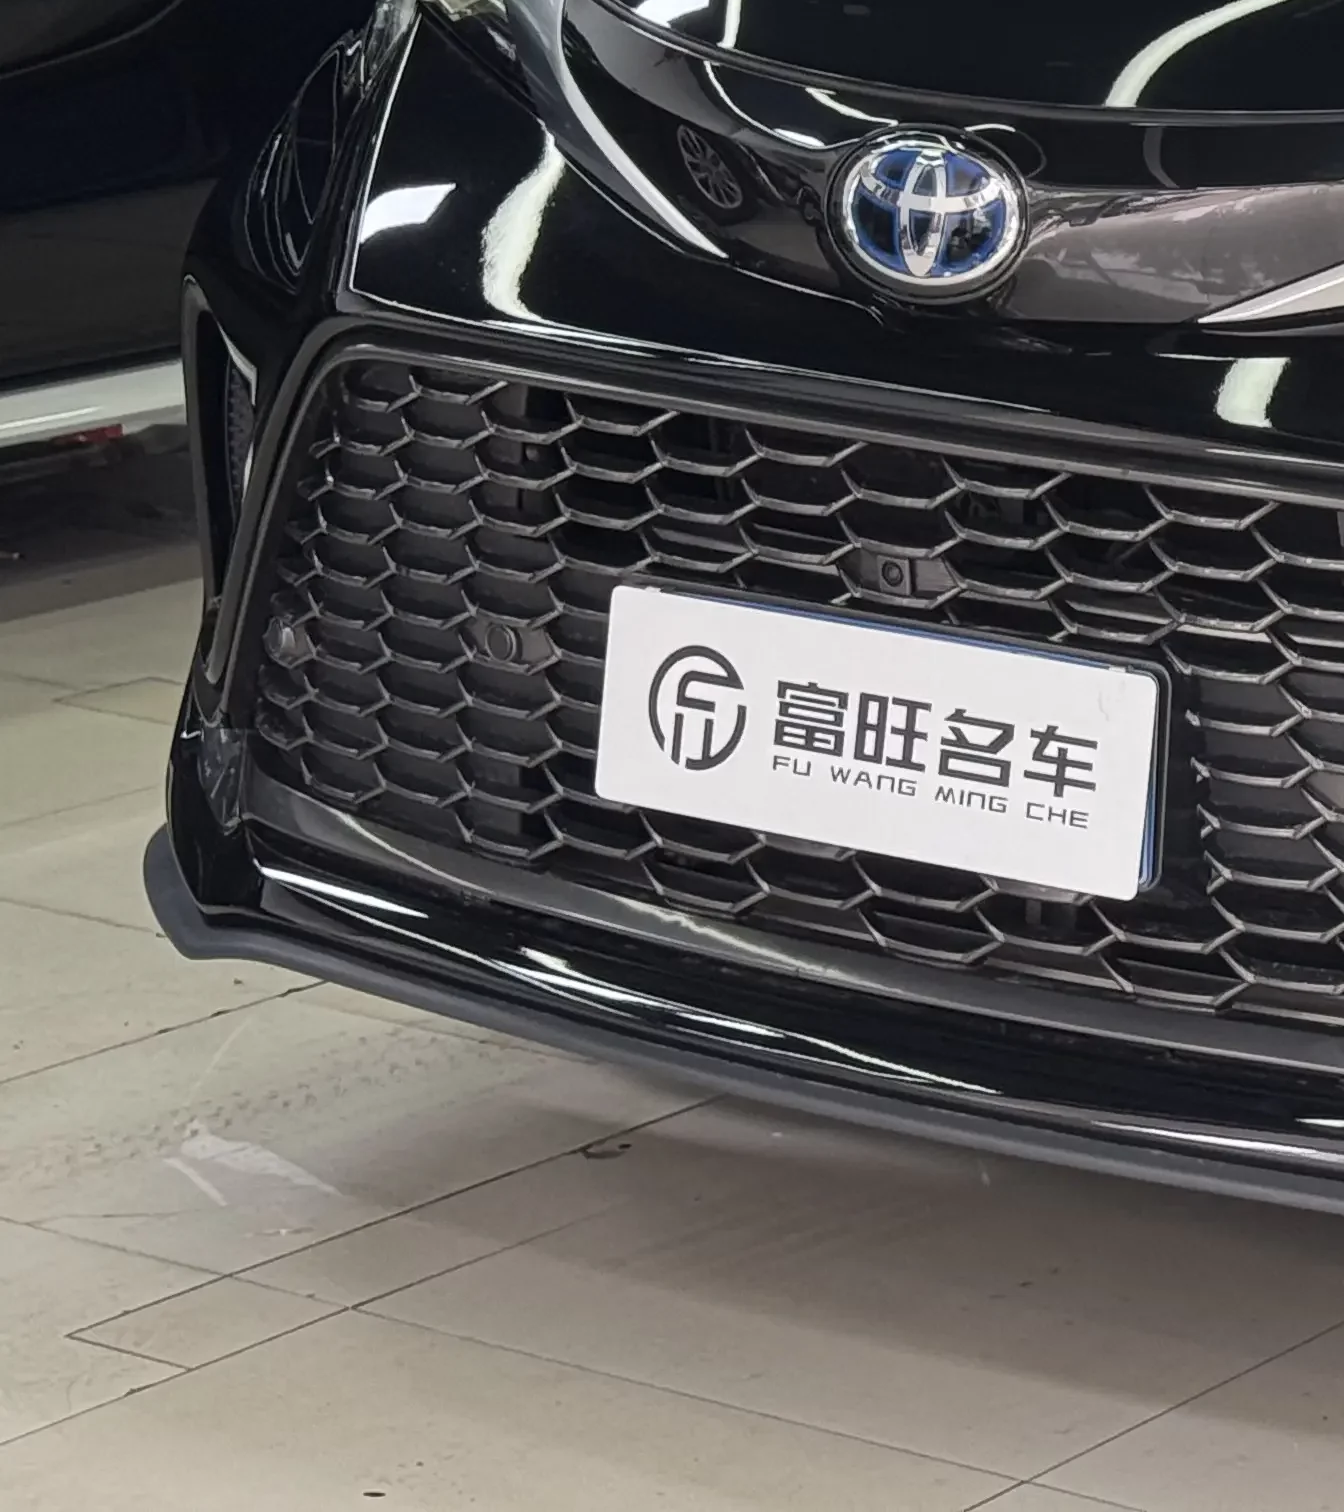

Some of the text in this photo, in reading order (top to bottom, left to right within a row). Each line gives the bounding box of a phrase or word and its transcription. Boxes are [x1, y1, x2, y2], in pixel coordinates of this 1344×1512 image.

[773, 679, 1099, 798] 富旺名车
[772, 755, 1090, 830] FU WANG MING CHE
